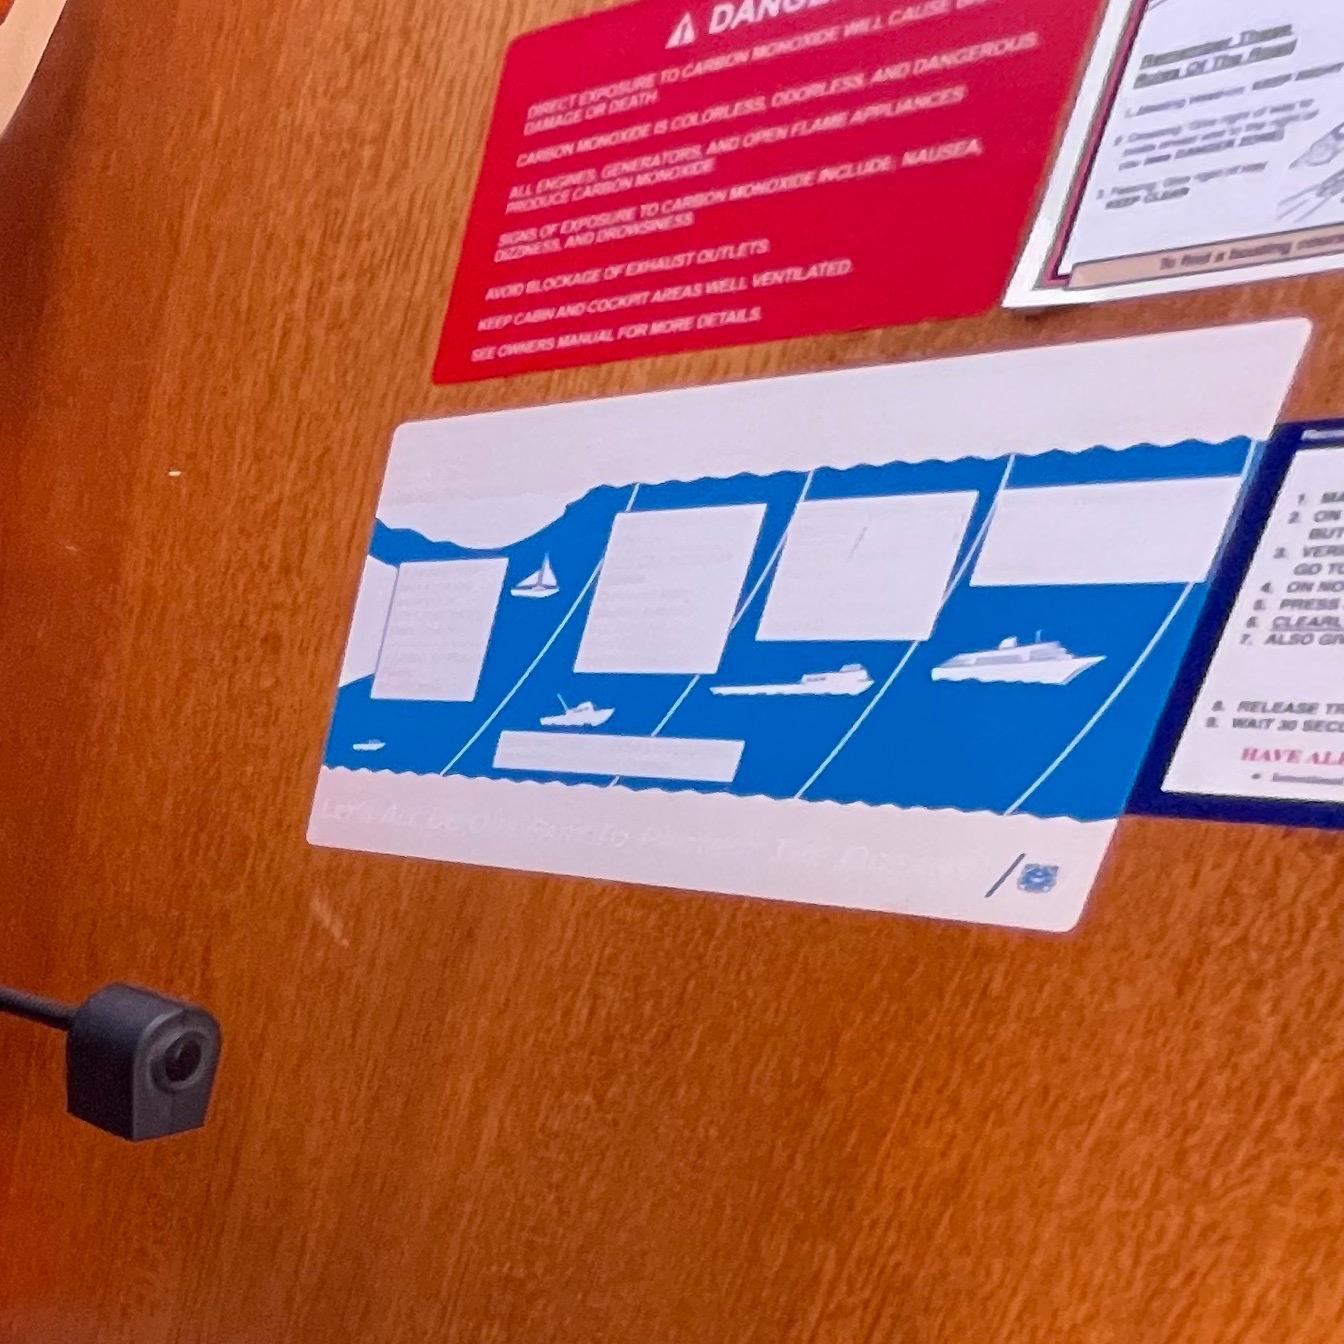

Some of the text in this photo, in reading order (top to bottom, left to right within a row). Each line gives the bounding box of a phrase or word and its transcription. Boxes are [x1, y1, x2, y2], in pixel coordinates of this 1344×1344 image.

[527, 0, 950, 119] DIRECT EXPOSURE TO CARBON MONOXIDE WILL CAUSE
[516, 143, 574, 168] CARBON
[576, 123, 652, 153] MONOXIDE
[653, 119, 669, 134] IS
[871, 62, 911, 83] AND
[524, 109, 582, 136] DAMAGE
[585, 103, 607, 119] OR
[509, 185, 532, 199] ALL
[707, 136, 740, 154] AND
[742, 125, 788, 147] OPEN
[790, 110, 849, 136] FLAME
[498, 227, 538, 247] SIGNS
[539, 223, 561, 238] OF
[561, 206, 637, 234] EXPOSURE
[640, 201, 660, 218] TO
[662, 188, 729, 214] CARBON
[729, 168, 817, 201] MONOXIDE
[506, 190, 571, 214] PRODUCE
[572, 177, 634, 201] CARBON
[563, 231, 595, 248] AND
[485, 283, 524, 300] AVOID
[525, 269, 602, 294] BLOCKAGE
[603, 264, 625, 280] OF
[625, 251, 696, 276] EXHAUST
[477, 315, 512, 331] KEEP
[513, 307, 556, 326] CABIN
[555, 302, 587, 319] AND
[586, 291, 650, 314] COCKPIT
[651, 283, 703, 302] AREAS
[705, 276, 749, 294] WELL
[471, 346, 497, 361] SEE
[497, 337, 555, 358] OWNERS
[557, 329, 615, 348] MANUAL
[617, 323, 649, 339] FOR
[649, 315, 696, 335] MORE
[1293, 563, 1322, 575] GO
[1279, 598, 1340, 610] PRESS
[1264, 633, 1314, 645] ALSO
[1232, 718, 1275, 729] WAIT
[1237, 701, 1319, 713] RELEASE
[1241, 747, 1302, 764] HAVE
